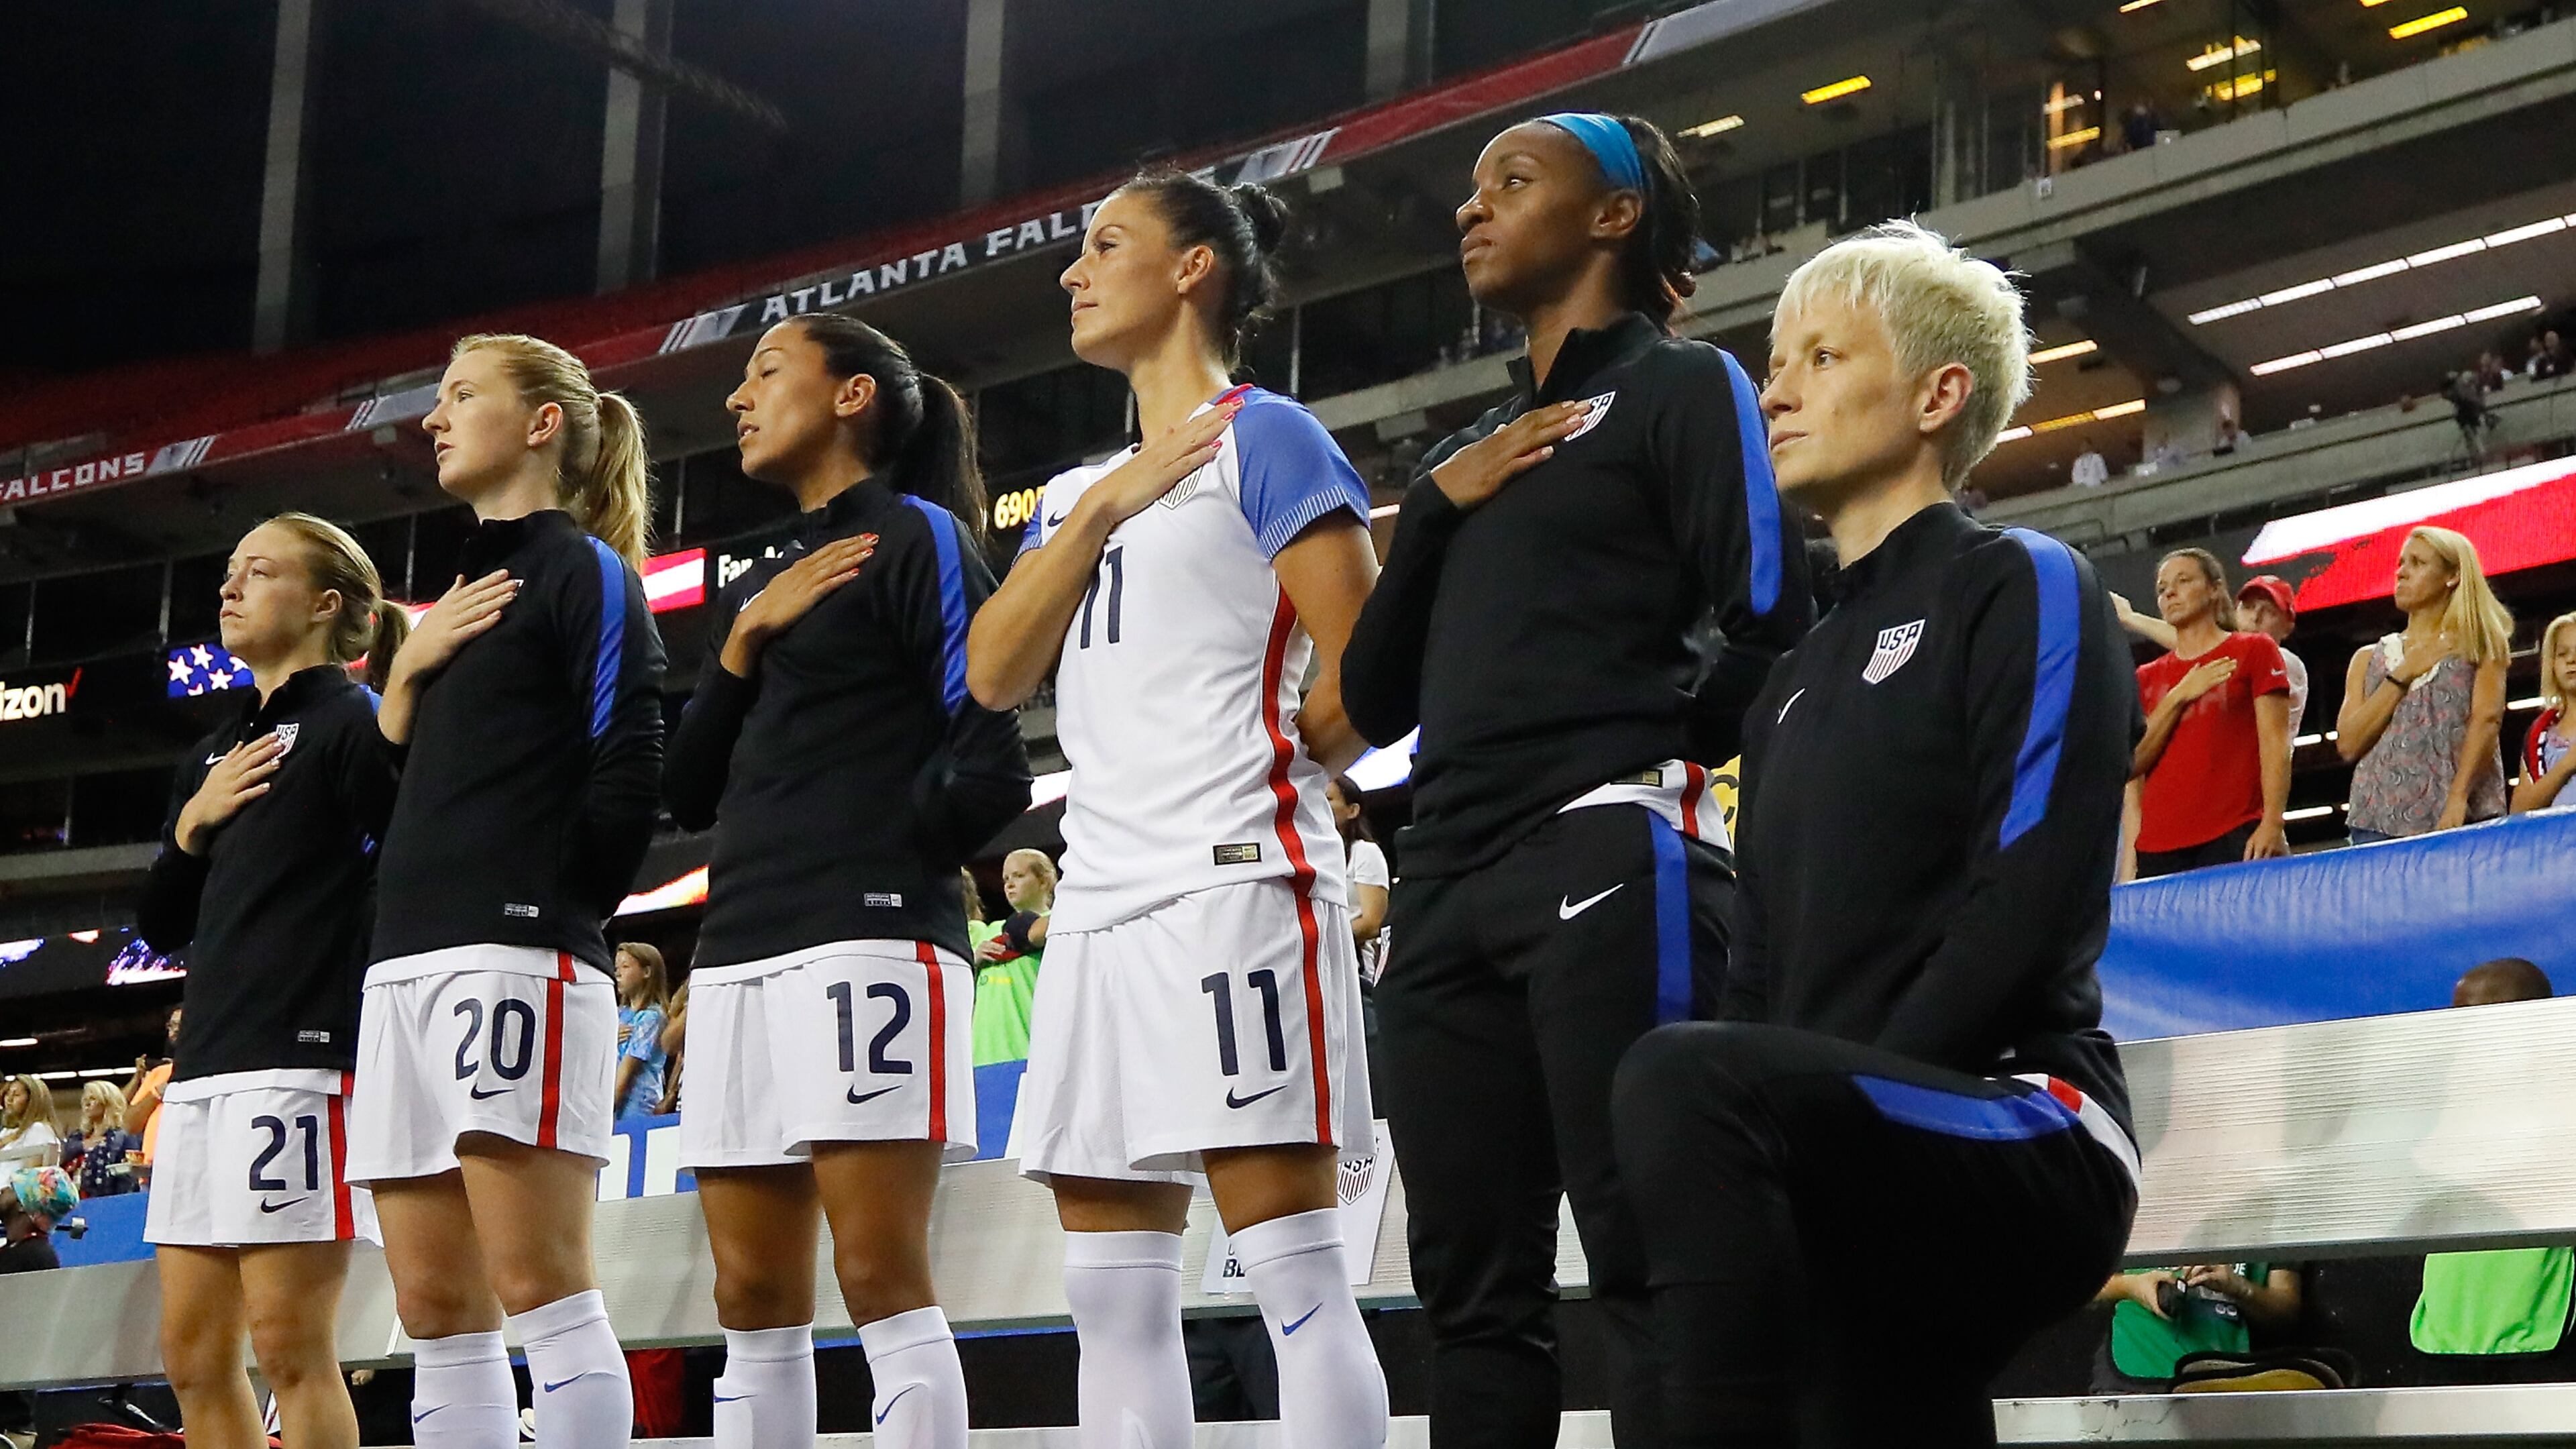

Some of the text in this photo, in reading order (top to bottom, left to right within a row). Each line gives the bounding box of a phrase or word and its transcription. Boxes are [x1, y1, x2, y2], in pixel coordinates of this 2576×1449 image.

[761, 242, 967, 322] ATLANTA
[0, 451, 144, 500] ALCONS
[1080, 546, 1123, 649] 11
[1879, 623, 1921, 651] USA
[277, 726, 297, 741] USA
[453, 998, 536, 1081] 20
[826, 981, 913, 1074] 12
[1201, 969, 1287, 1076] 11
[249, 1115, 319, 1191] 21
